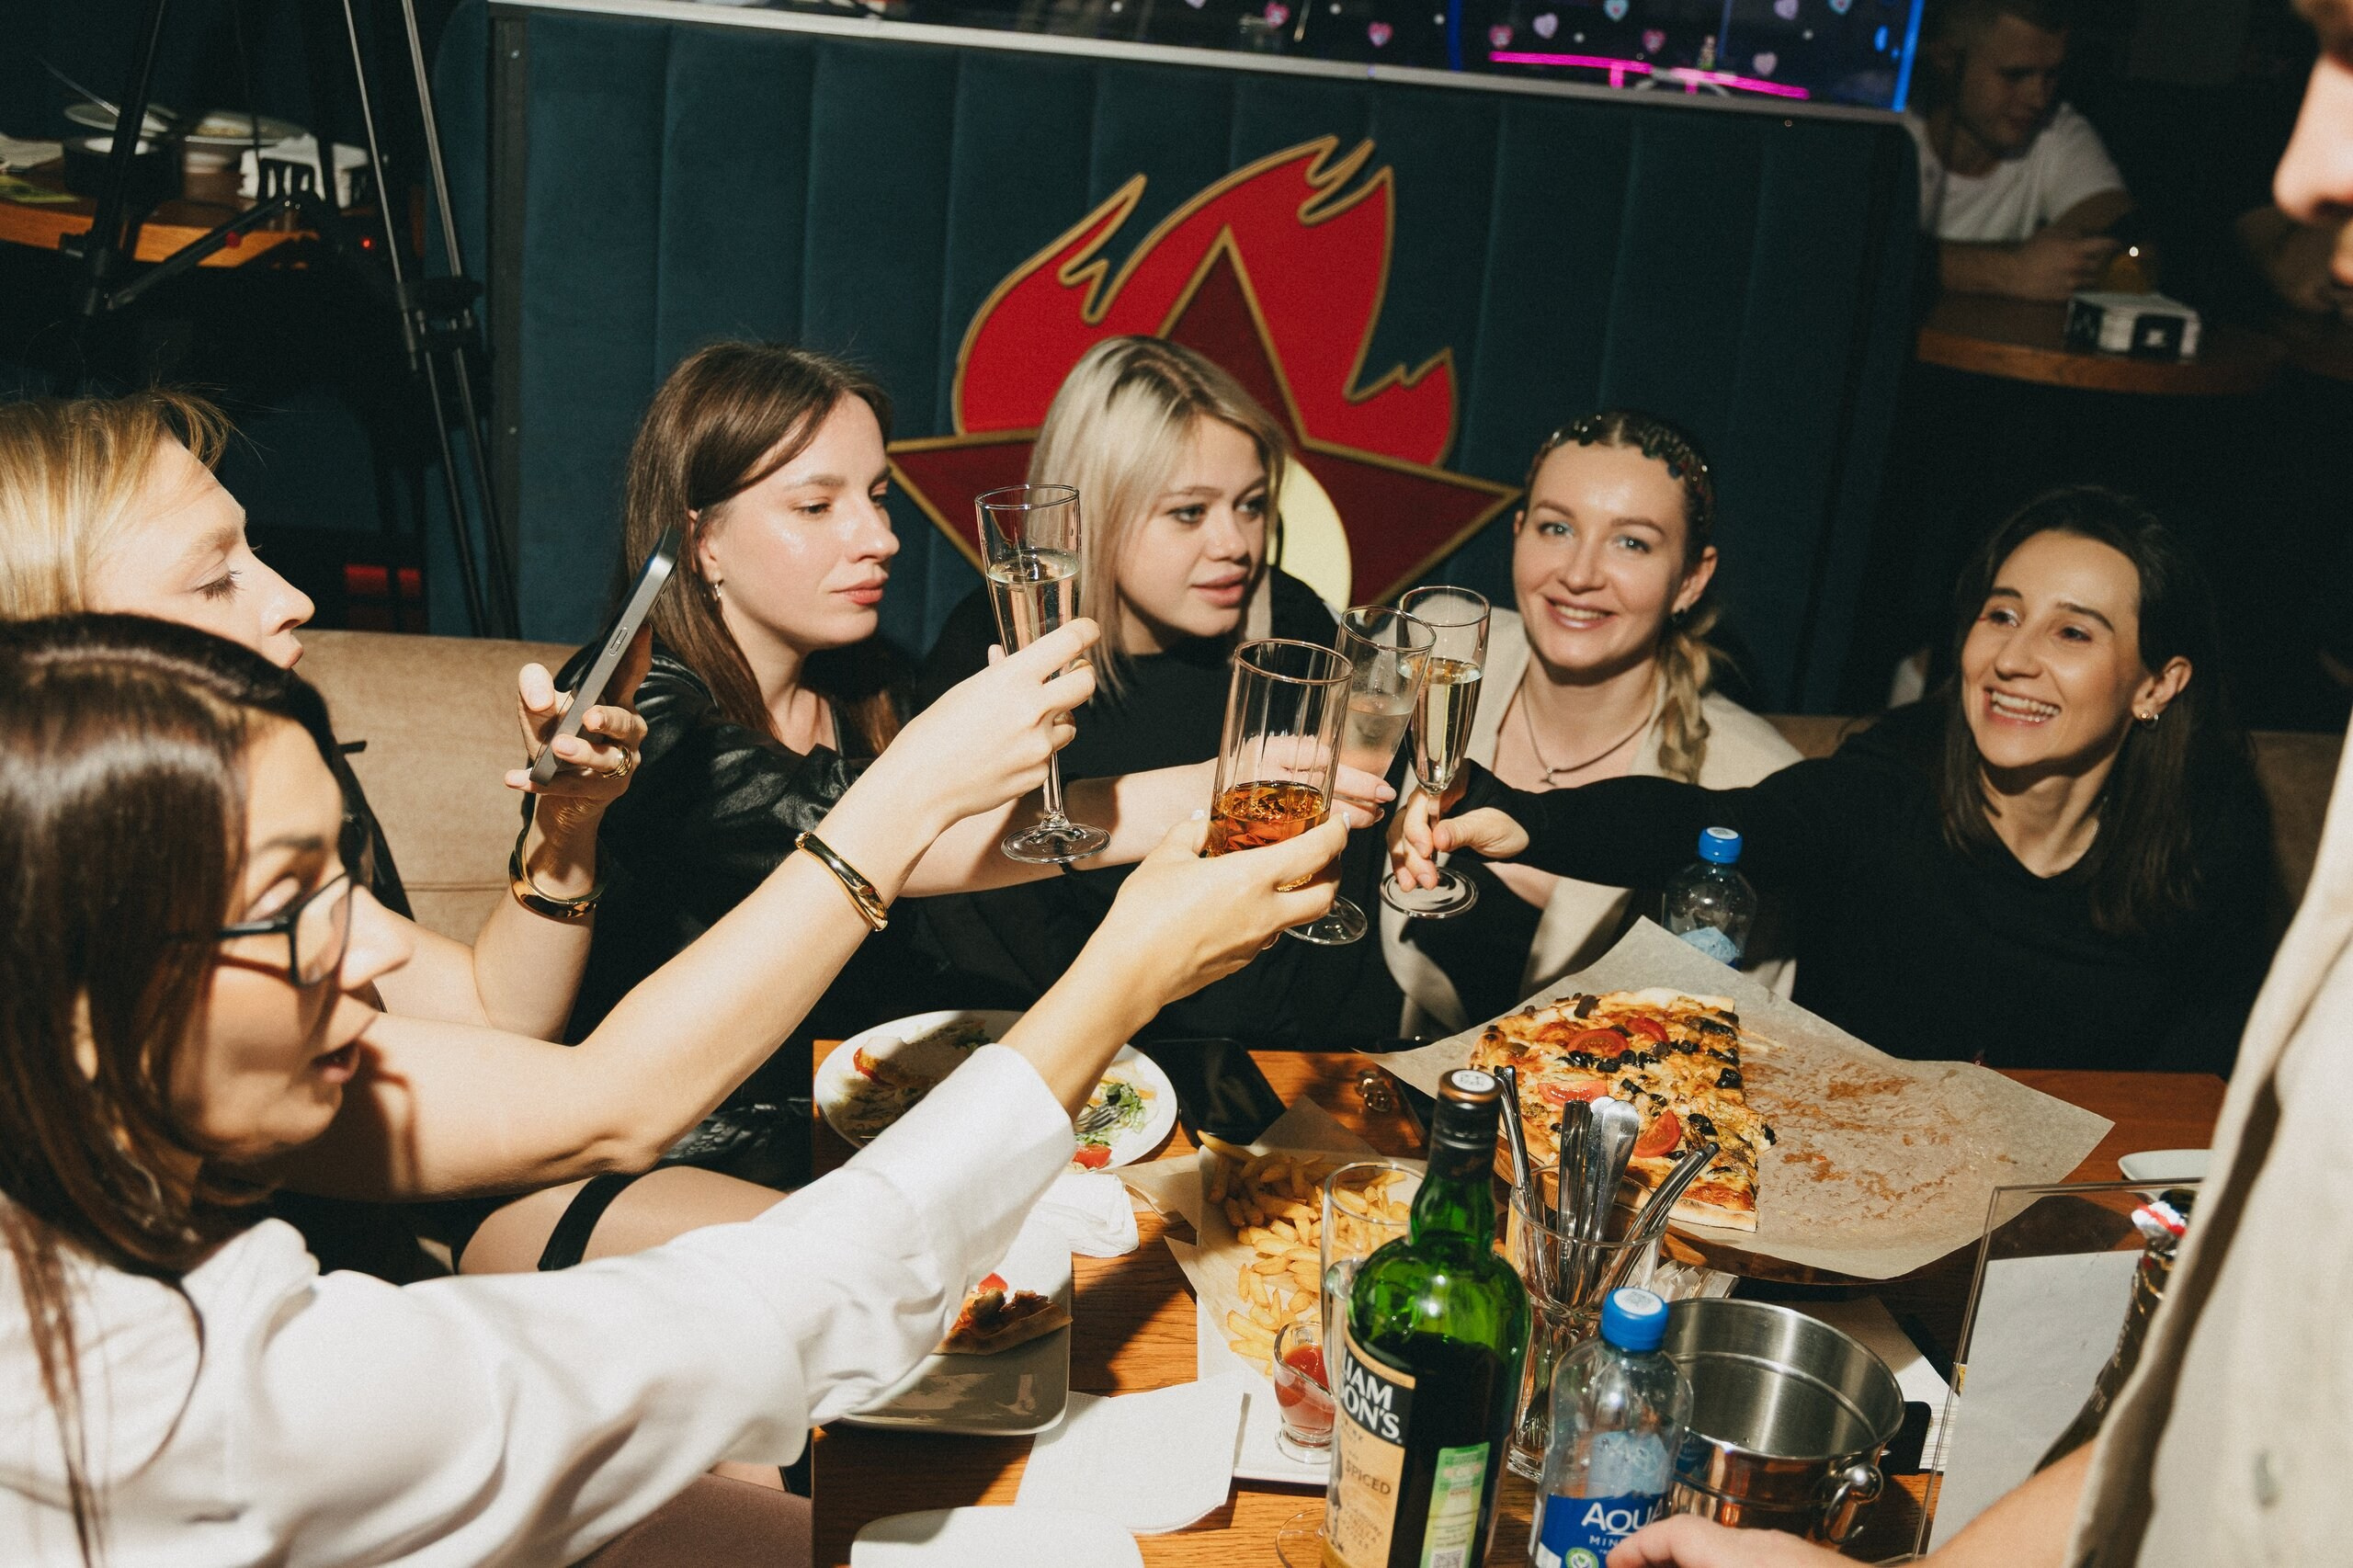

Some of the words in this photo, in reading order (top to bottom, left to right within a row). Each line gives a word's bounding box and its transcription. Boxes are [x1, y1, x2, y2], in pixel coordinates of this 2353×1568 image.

[1341, 1384, 1401, 1439] ON'S
[1345, 1460, 1392, 1495] SPICED
[1589, 1534, 1619, 1547] MIN
